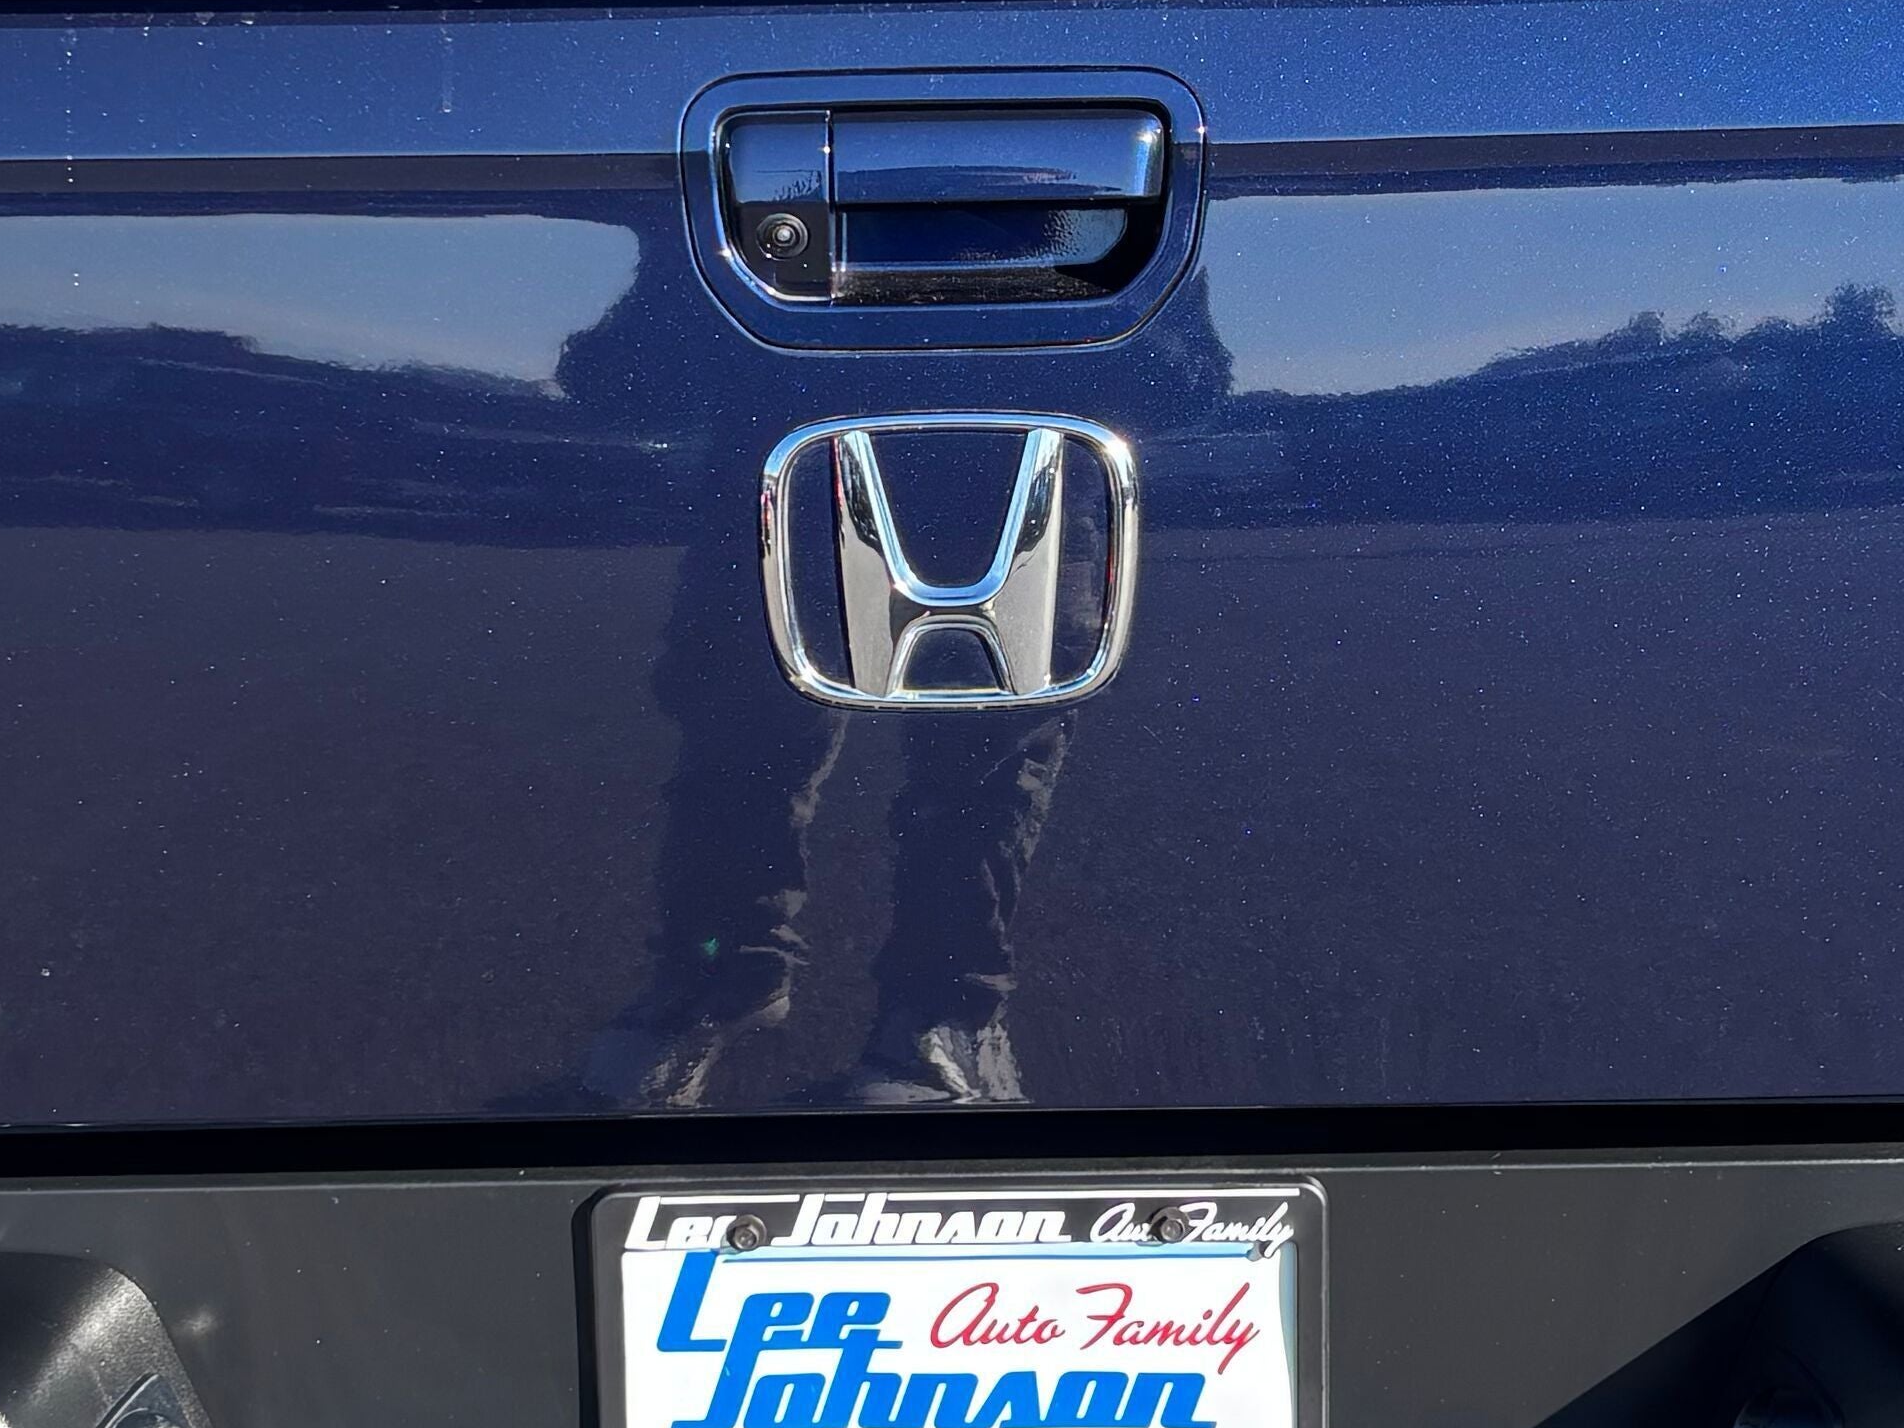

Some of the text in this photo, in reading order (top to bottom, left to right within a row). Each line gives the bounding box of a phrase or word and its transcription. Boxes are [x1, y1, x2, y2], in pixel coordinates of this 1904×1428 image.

[770, 1192, 1072, 1246] Johnson
[1179, 1201, 1294, 1258] Family
[656, 1251, 1261, 1375] Lee Auto Family
